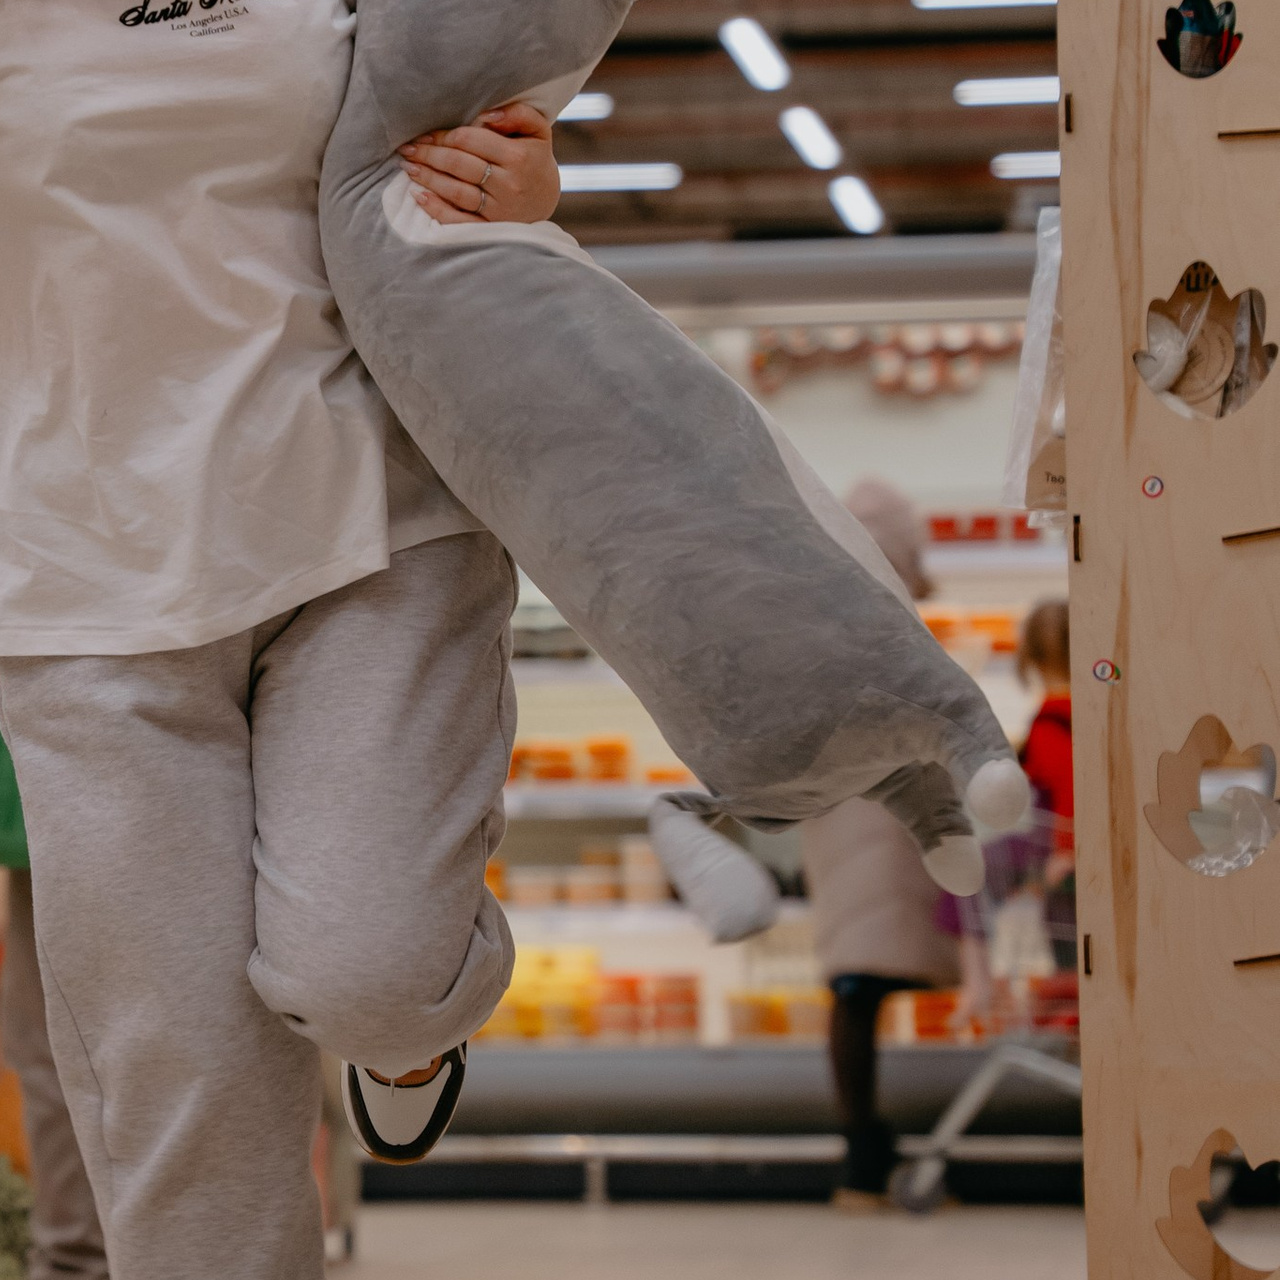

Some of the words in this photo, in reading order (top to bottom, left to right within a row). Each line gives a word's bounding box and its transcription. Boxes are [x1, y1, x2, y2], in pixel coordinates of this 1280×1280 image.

[171, 22, 187, 31] Los
[189, 15, 223, 29] Angeles
[189, 24, 235, 38] California
